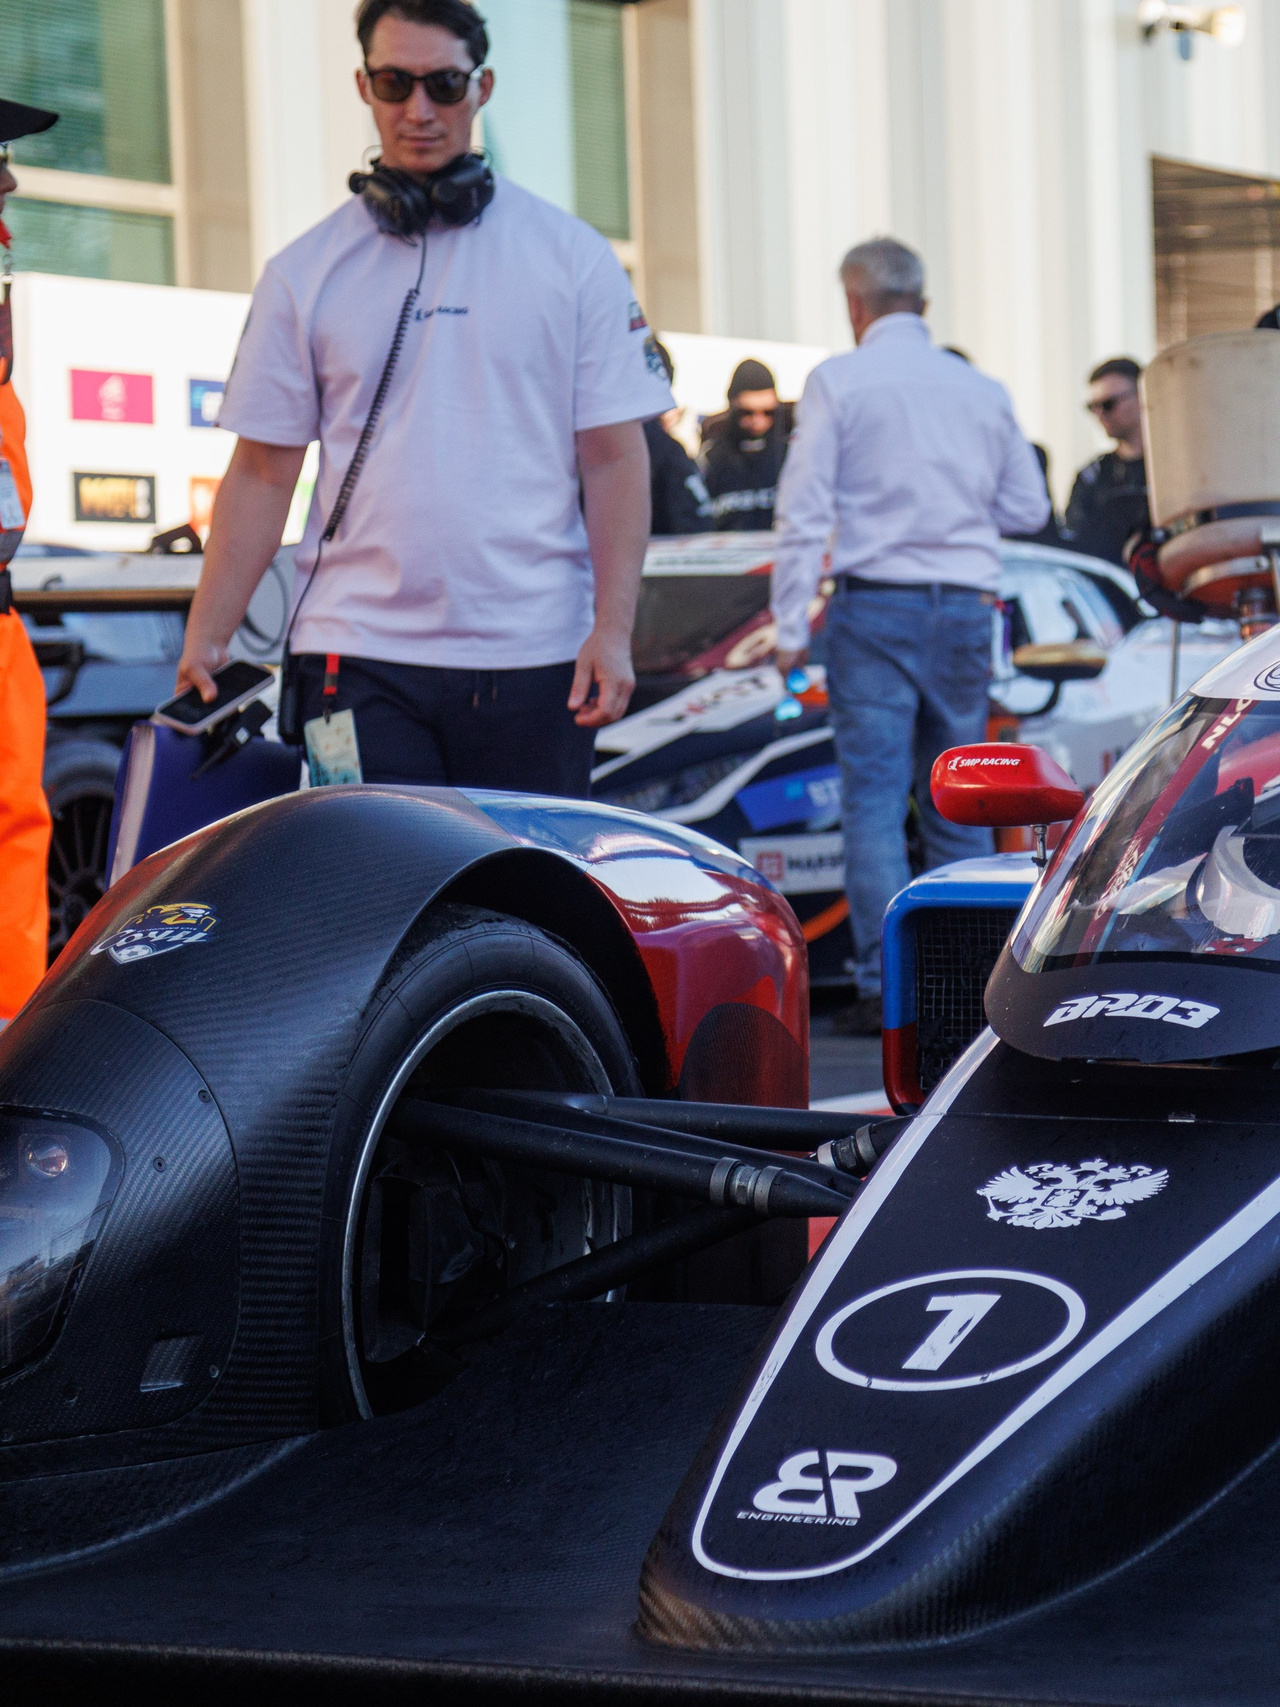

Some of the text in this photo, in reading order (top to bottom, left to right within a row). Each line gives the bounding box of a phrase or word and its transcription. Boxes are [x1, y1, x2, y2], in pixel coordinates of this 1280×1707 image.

[959, 758, 1021, 768] SMP RACING
[901, 1293, 1002, 1371] 1
[736, 1510, 860, 1527] ENGINEERING
